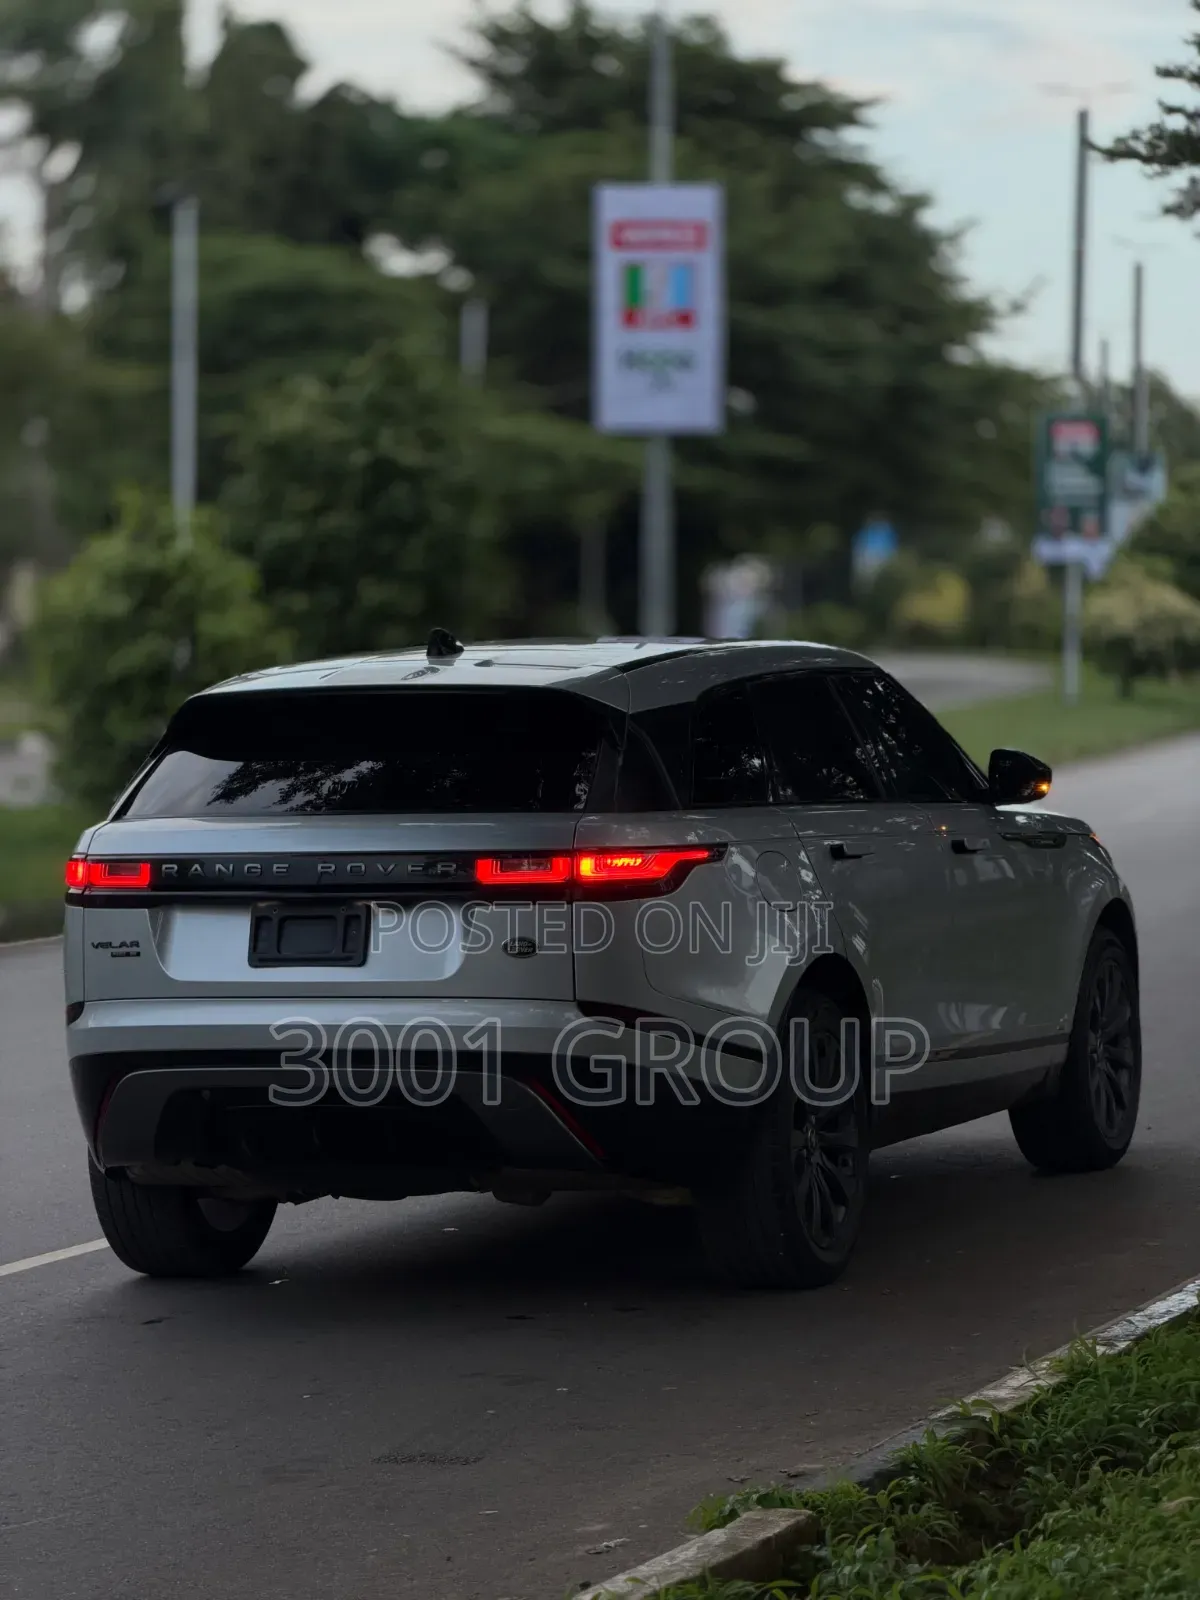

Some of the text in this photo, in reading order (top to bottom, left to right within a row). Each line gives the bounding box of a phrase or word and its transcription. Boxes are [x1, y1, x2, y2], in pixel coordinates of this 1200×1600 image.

[161, 862, 457, 877] RANGE ROVER
[91, 940, 140, 949] VELAR
